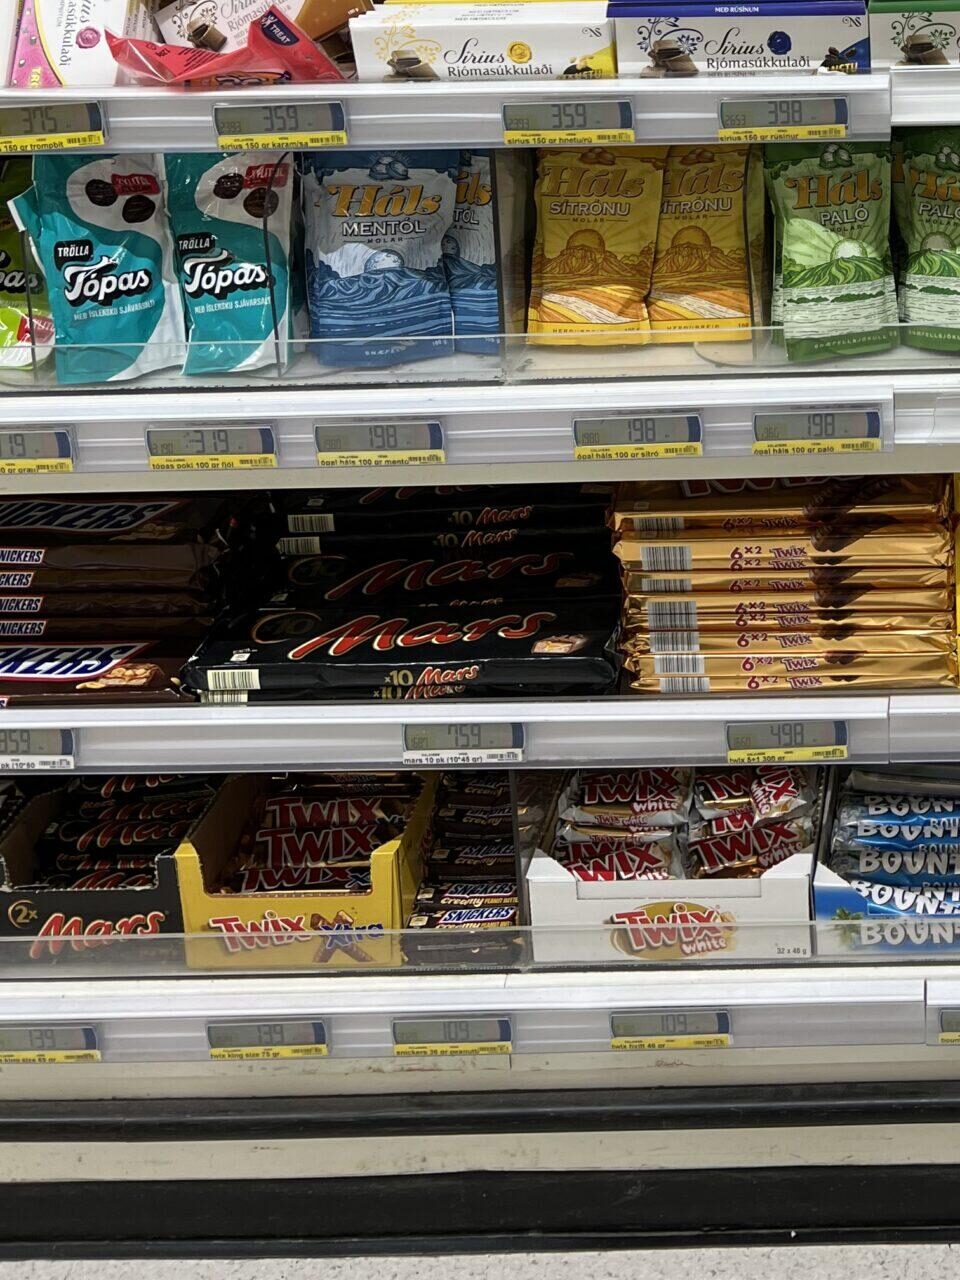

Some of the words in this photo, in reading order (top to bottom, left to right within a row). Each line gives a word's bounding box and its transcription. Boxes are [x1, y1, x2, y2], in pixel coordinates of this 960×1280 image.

[715, 6, 731, 14] MEÐ
[734, 5, 760, 14] RÚSÍNUM
[270, 21, 290, 44] TREAT
[447, 63, 553, 78] Rjómasúkkulaði
[706, 55, 811, 71] Rjómasúkkulaði
[264, 107, 298, 131] 359
[551, 103, 586, 128] 359
[768, 101, 802, 125] 398
[327, 182, 442, 219] Háls
[783, 170, 884, 210] Háls
[550, 196, 631, 217] SÍTRÓNU
[819, 204, 870, 226] PALÓ
[342, 217, 425, 236] MENTÓL
[58, 243, 89, 258] TRÖLLA
[178, 235, 211, 251] TRÖLLA
[64, 255, 150, 301] Tópas
[183, 250, 266, 295] Tópas
[629, 419, 655, 443] 198
[808, 414, 836, 436] 198
[369, 426, 397, 449] 198
[290, 612, 556, 660] Mars
[782, 655, 819, 672] Twix
[416, 665, 480, 686] Mars
[787, 674, 822, 689] Twix
[448, 724, 481, 748] 759
[771, 723, 803, 745] 498
[440, 906, 516, 926] SNICKERS
[30, 910, 166, 959] Mars
[210, 909, 308, 955] Twix
[614, 905, 722, 951] Twix
[681, 937, 729, 957] white
